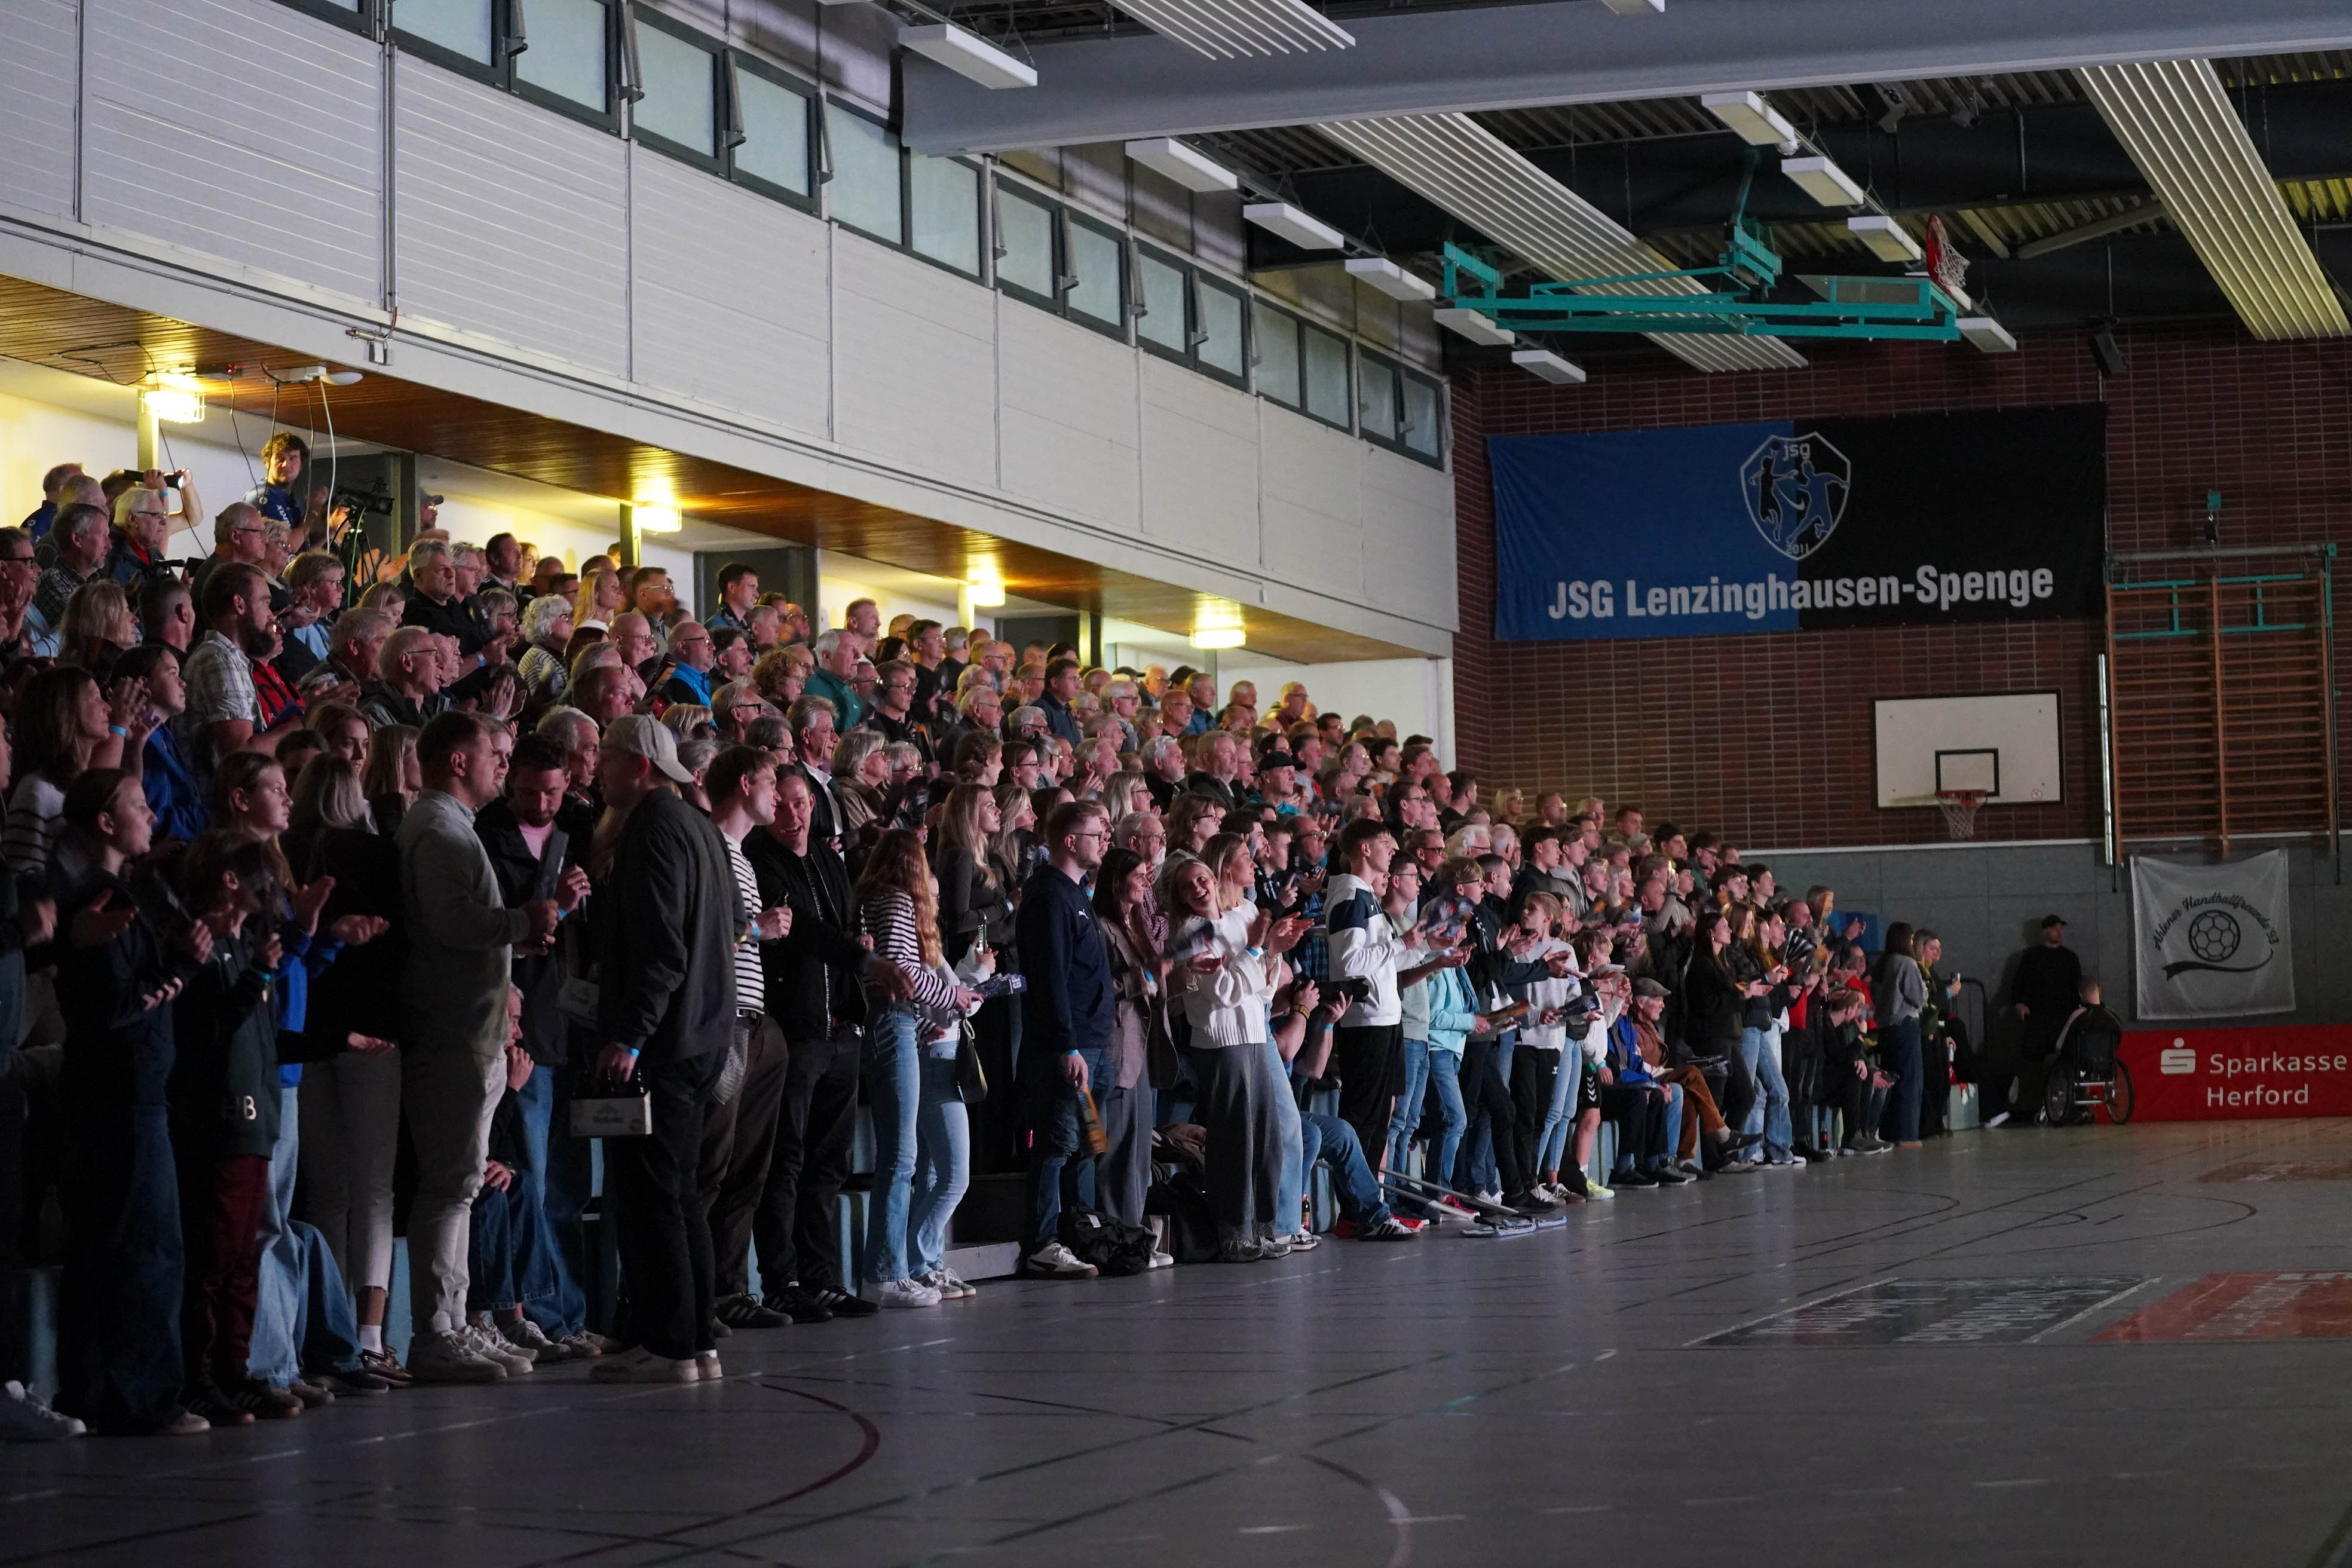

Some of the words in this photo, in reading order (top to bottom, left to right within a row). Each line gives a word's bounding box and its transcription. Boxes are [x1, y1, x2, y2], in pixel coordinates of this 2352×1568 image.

[1786, 542, 1810, 555] 2011
[1548, 579, 1614, 619] JSG
[1626, 565, 2053, 620] Lenzinghausen-Spenge
[2209, 1051, 2348, 1079] Sparkasse
[2207, 1083, 2310, 1107] Herford
